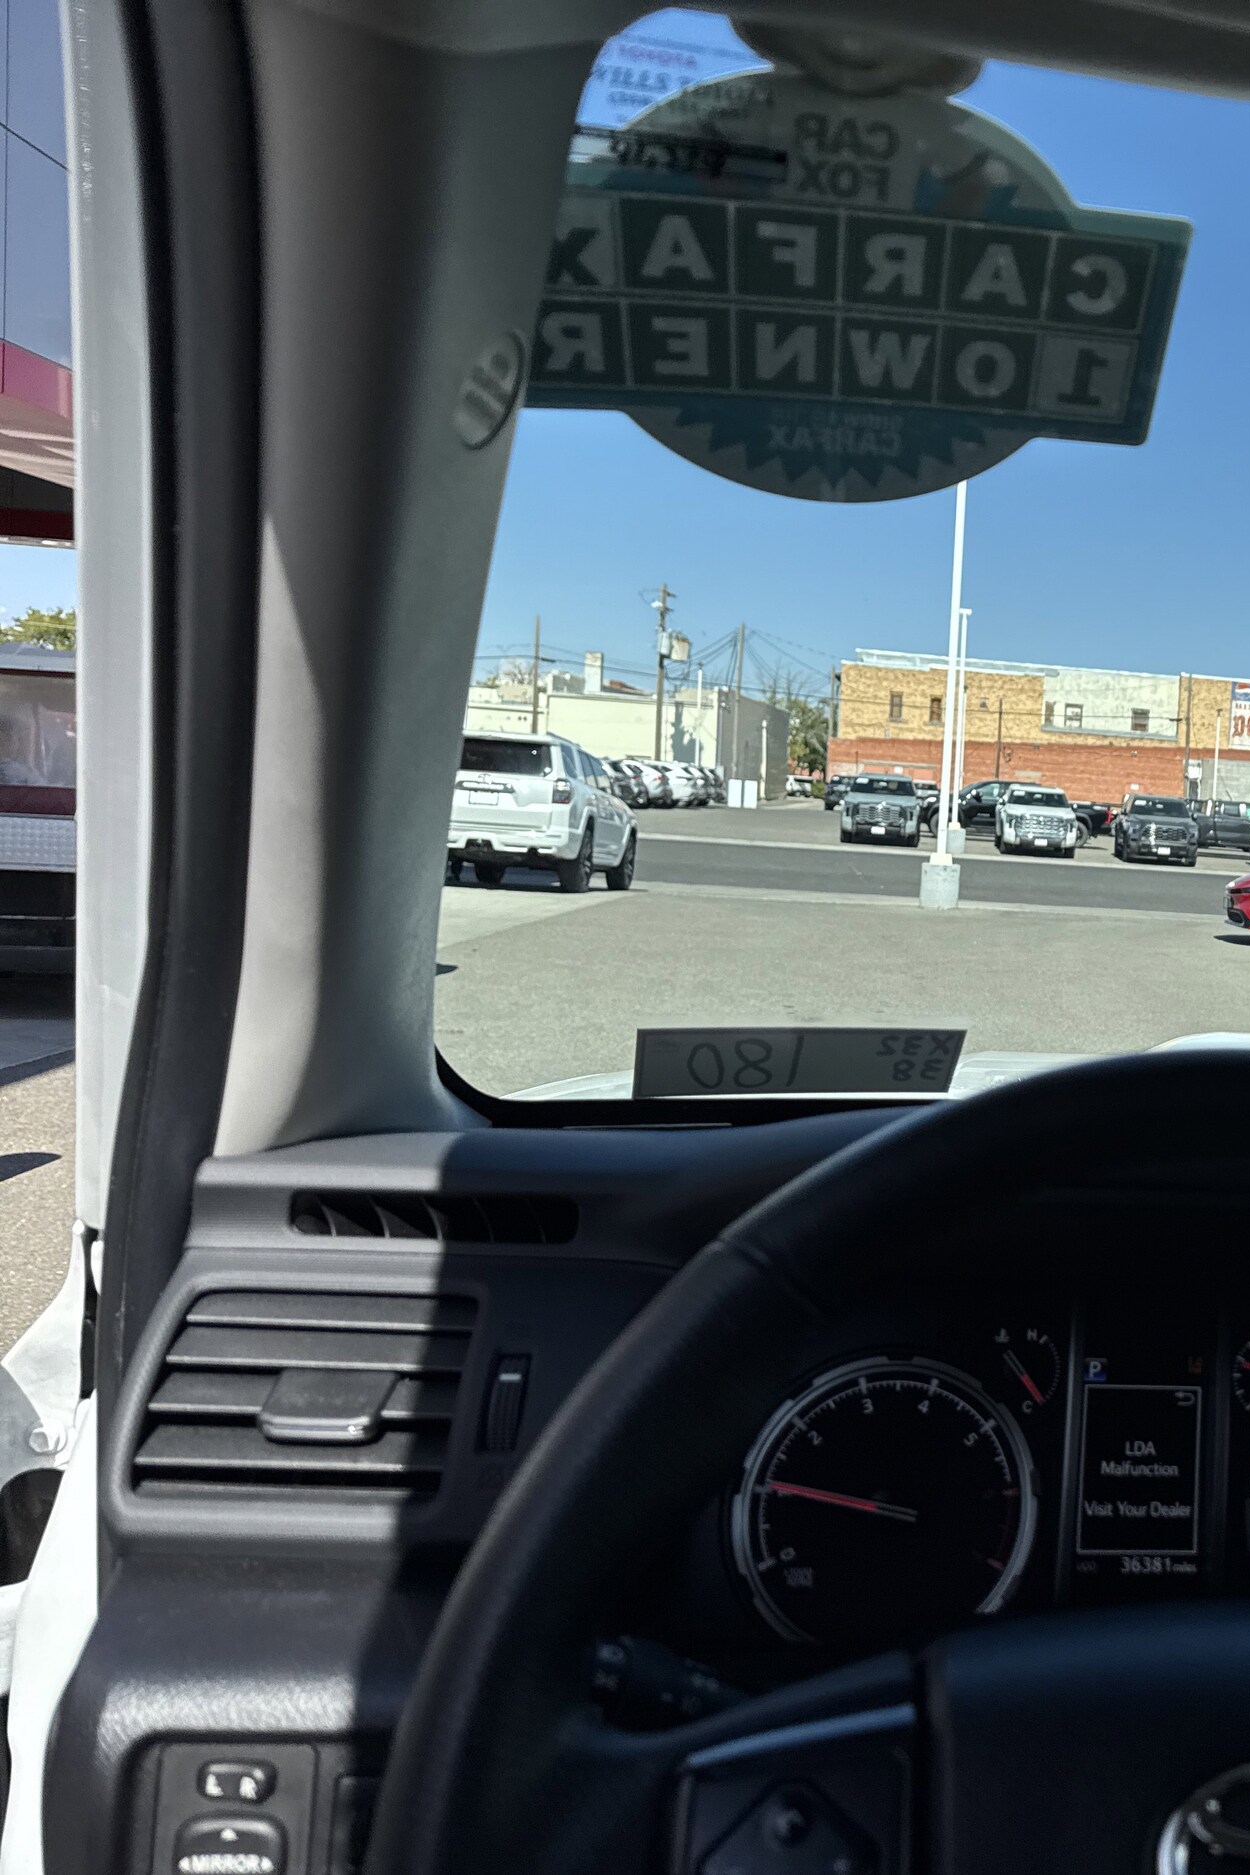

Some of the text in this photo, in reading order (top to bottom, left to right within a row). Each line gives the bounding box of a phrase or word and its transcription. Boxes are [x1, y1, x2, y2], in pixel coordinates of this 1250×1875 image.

[1027, 1328, 1038, 1340] H
[1090, 1361, 1102, 1378] P
[862, 1399, 874, 1414] 3
[918, 1399, 930, 1414] 4
[1022, 1400, 1033, 1413] C
[807, 1431, 823, 1446] 2
[963, 1432, 979, 1446] 5
[1125, 1440, 1156, 1456] LDA
[1101, 1460, 1179, 1478] Malfunction
[1084, 1500, 1192, 1518] Visit Your Dealer
[1121, 1556, 1170, 1574] 36381
[205, 1773, 258, 1800] L R
[192, 1853, 261, 1873] MIRROR
